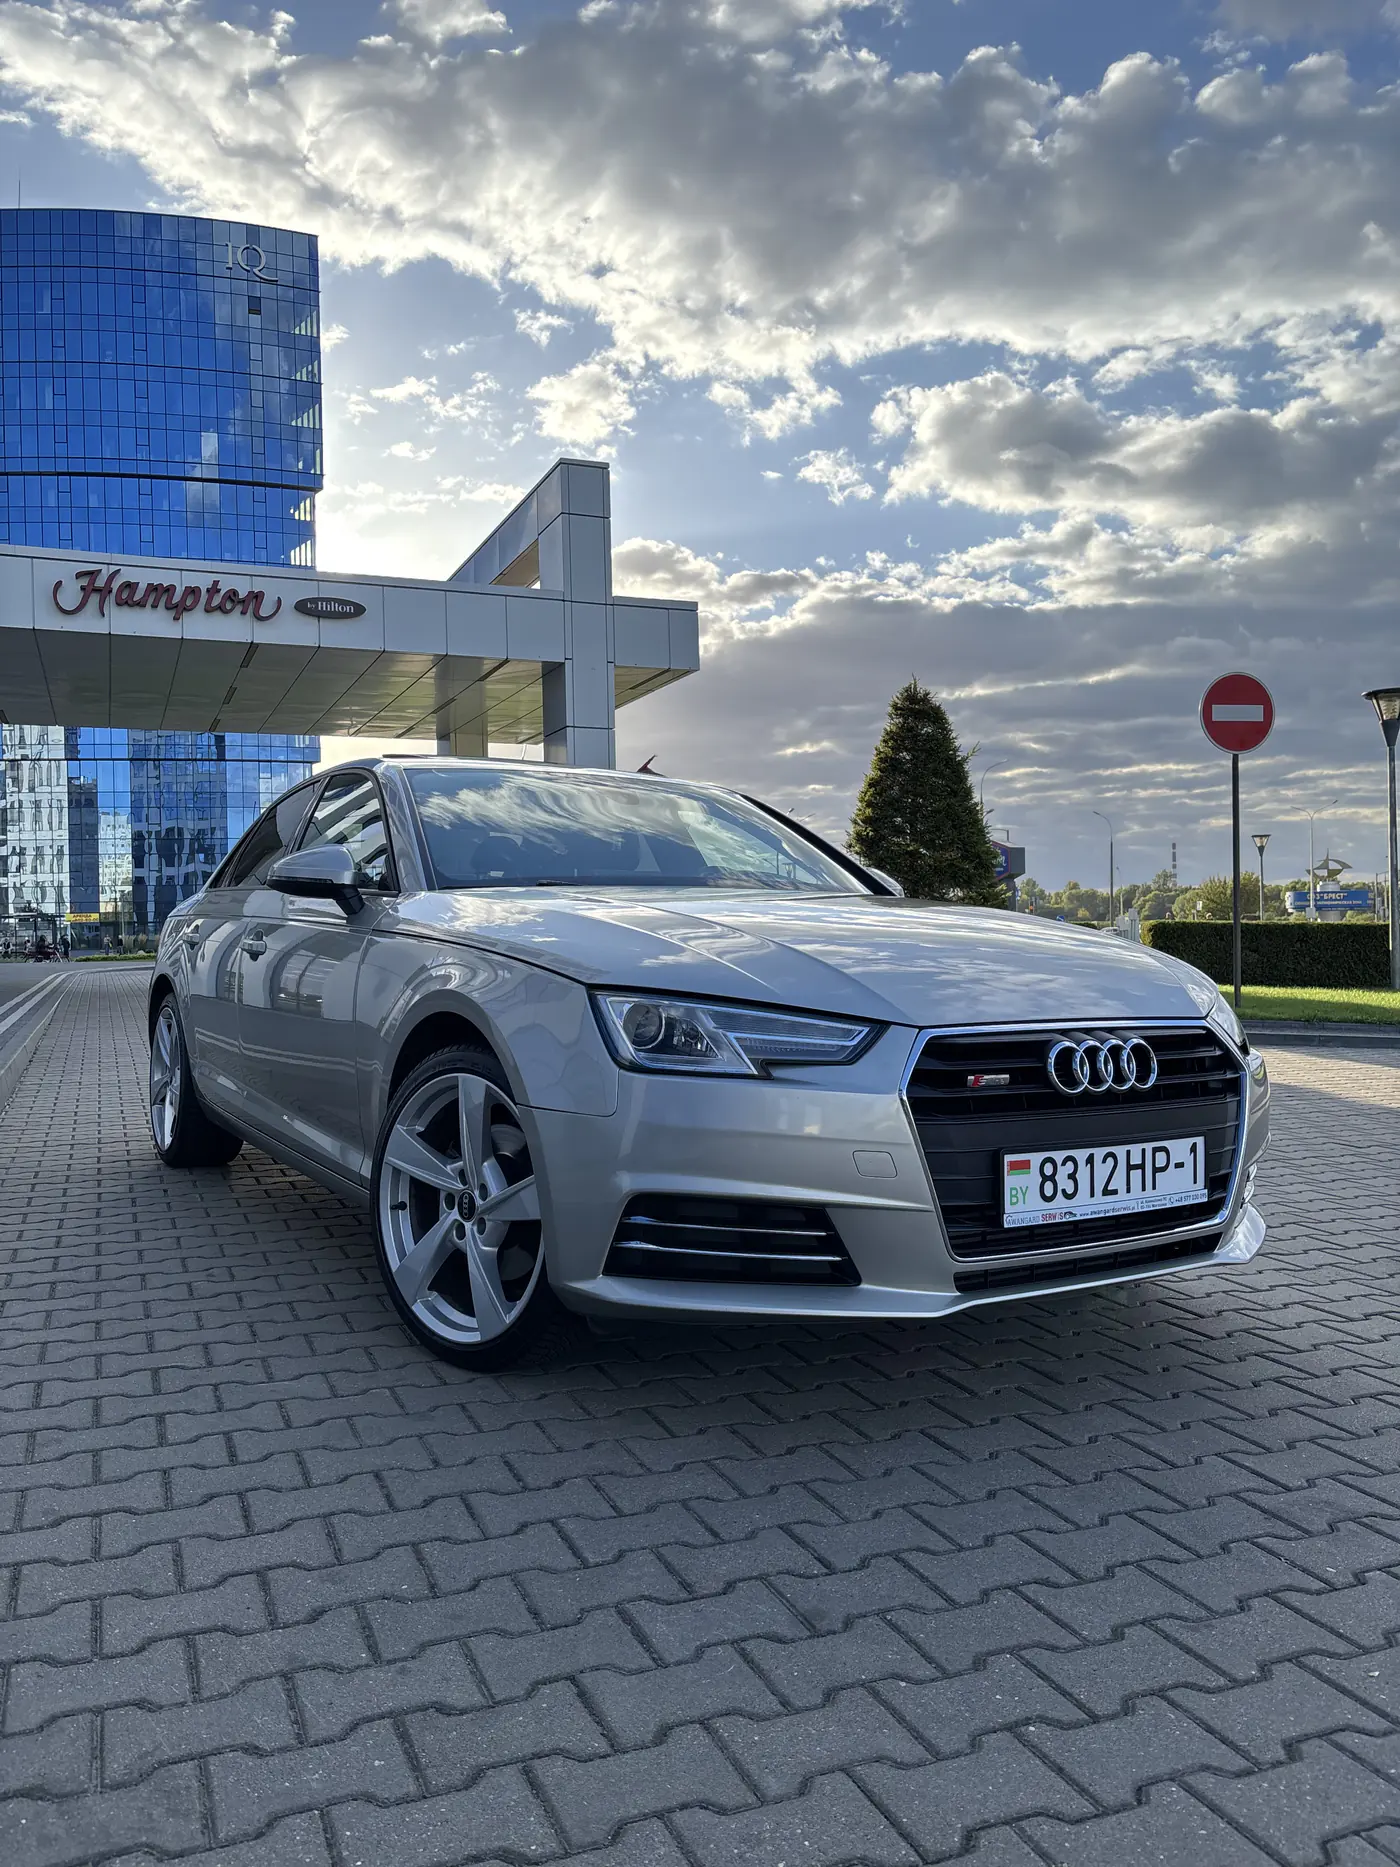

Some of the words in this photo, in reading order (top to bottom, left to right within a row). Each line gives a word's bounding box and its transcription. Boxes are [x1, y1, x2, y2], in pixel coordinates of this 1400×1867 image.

[225, 242, 279, 282] IQ
[52, 567, 282, 622] Hampton
[307, 601, 316, 610] by
[317, 601, 355, 613] Hilton
[1009, 1186, 1029, 1206] BY
